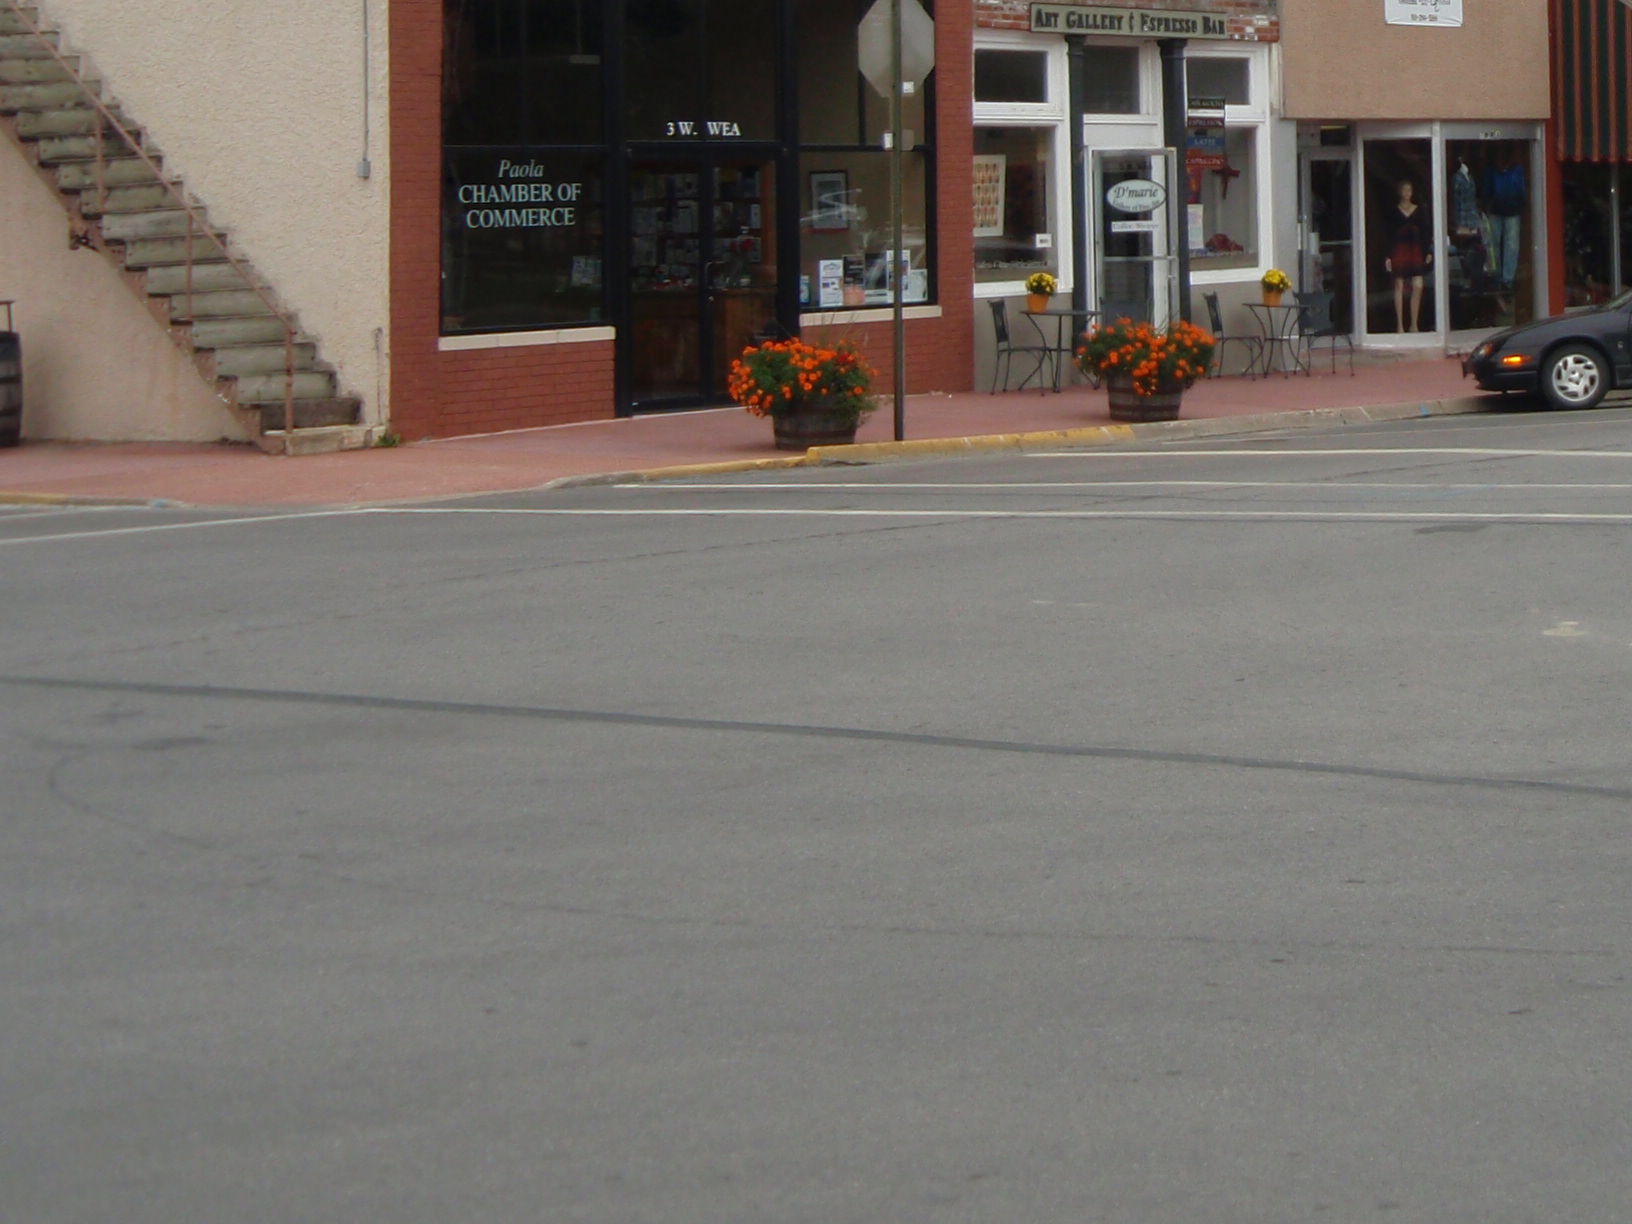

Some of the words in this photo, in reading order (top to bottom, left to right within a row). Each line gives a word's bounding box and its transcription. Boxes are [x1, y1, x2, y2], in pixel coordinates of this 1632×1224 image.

[1034, 7, 1059, 29] ART
[1066, 10, 1125, 32] GALLERY
[1140, 12, 1198, 34] ESPRESSO
[1202, 15, 1226, 36] BAR
[666, 121, 676, 136] 3
[706, 121, 742, 137] WEA
[497, 159, 545, 178] Paola
[458, 183, 553, 204] CHAMBER
[557, 182, 583, 203] OF
[466, 207, 577, 229] COMMERCE
